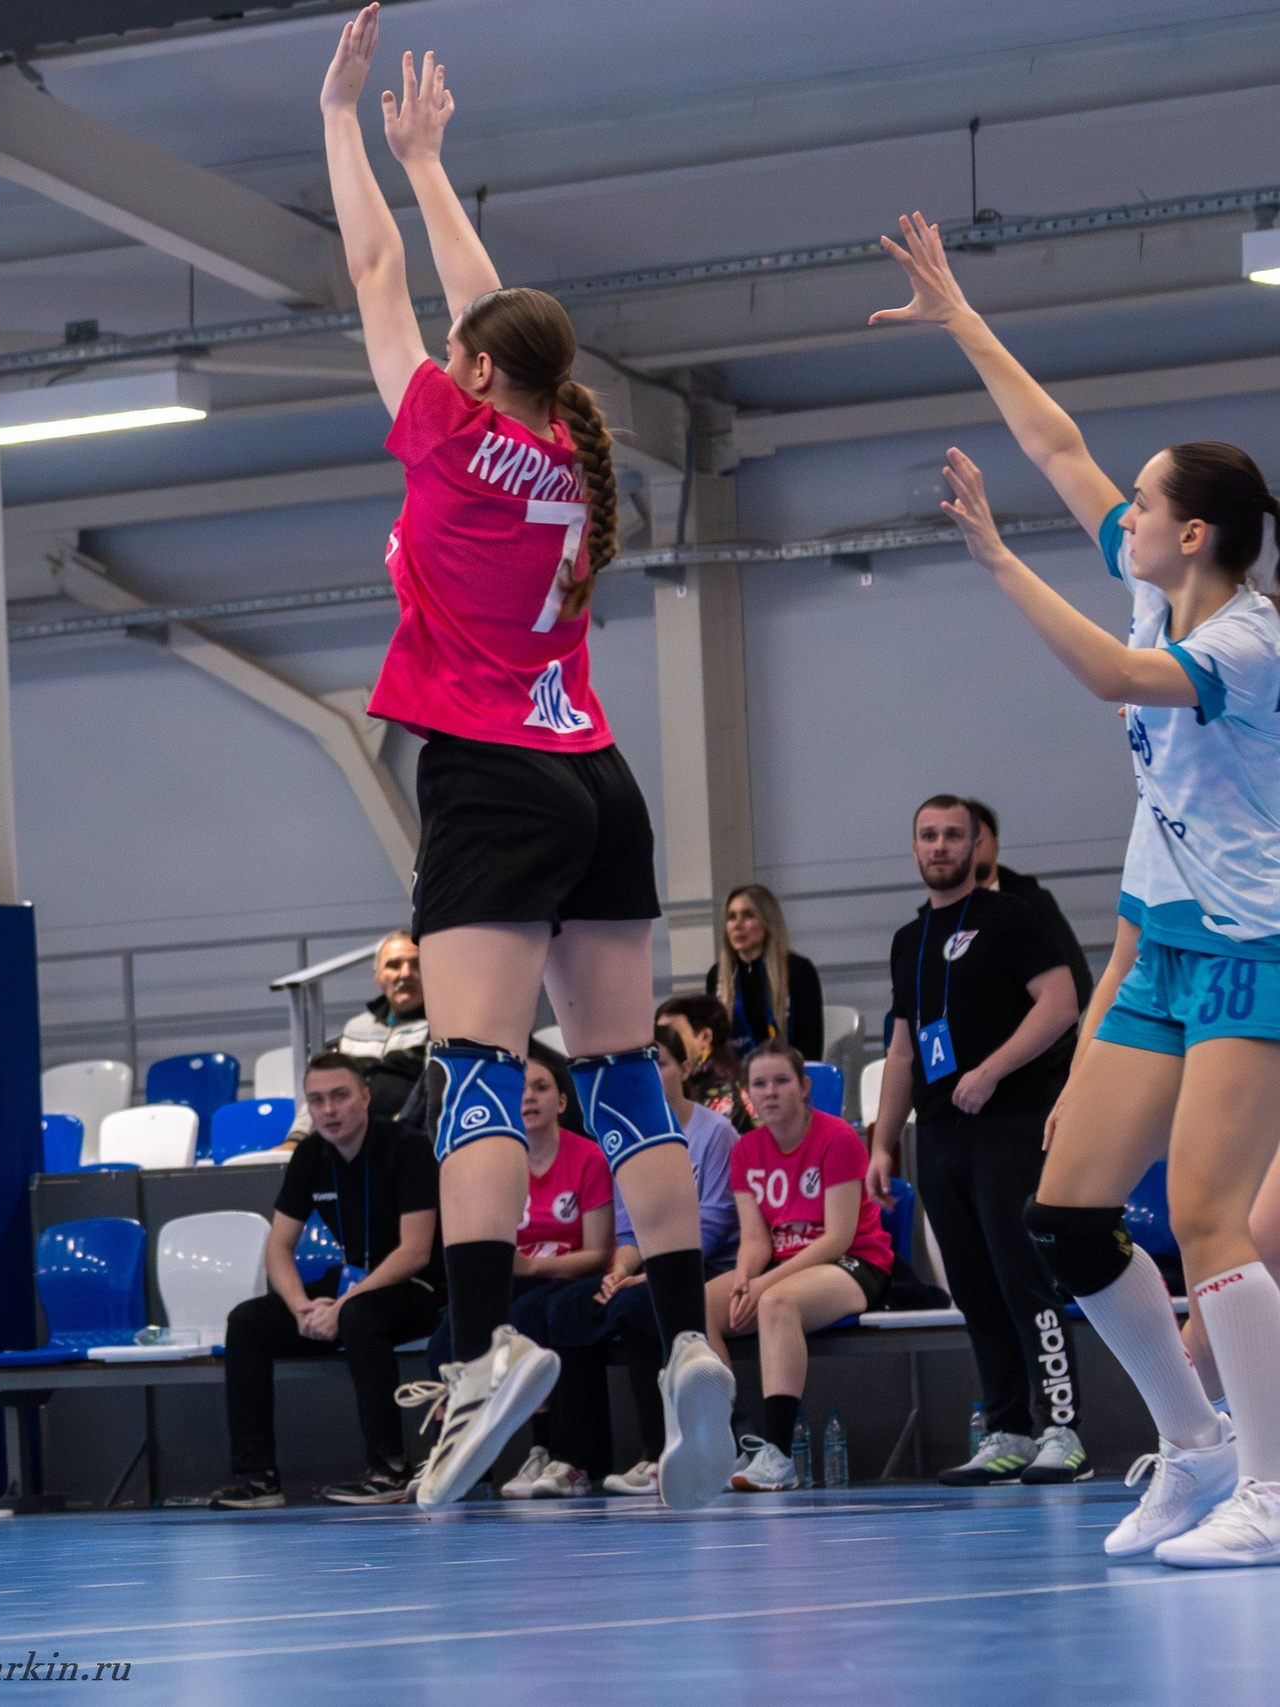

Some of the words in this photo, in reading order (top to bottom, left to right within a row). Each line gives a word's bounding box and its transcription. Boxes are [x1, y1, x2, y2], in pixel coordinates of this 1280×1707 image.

[525, 500, 587, 633] 7
[1198, 958, 1258, 1025] 38
[746, 1168, 789, 1208] 50
[1035, 1308, 1076, 1425] adidas
